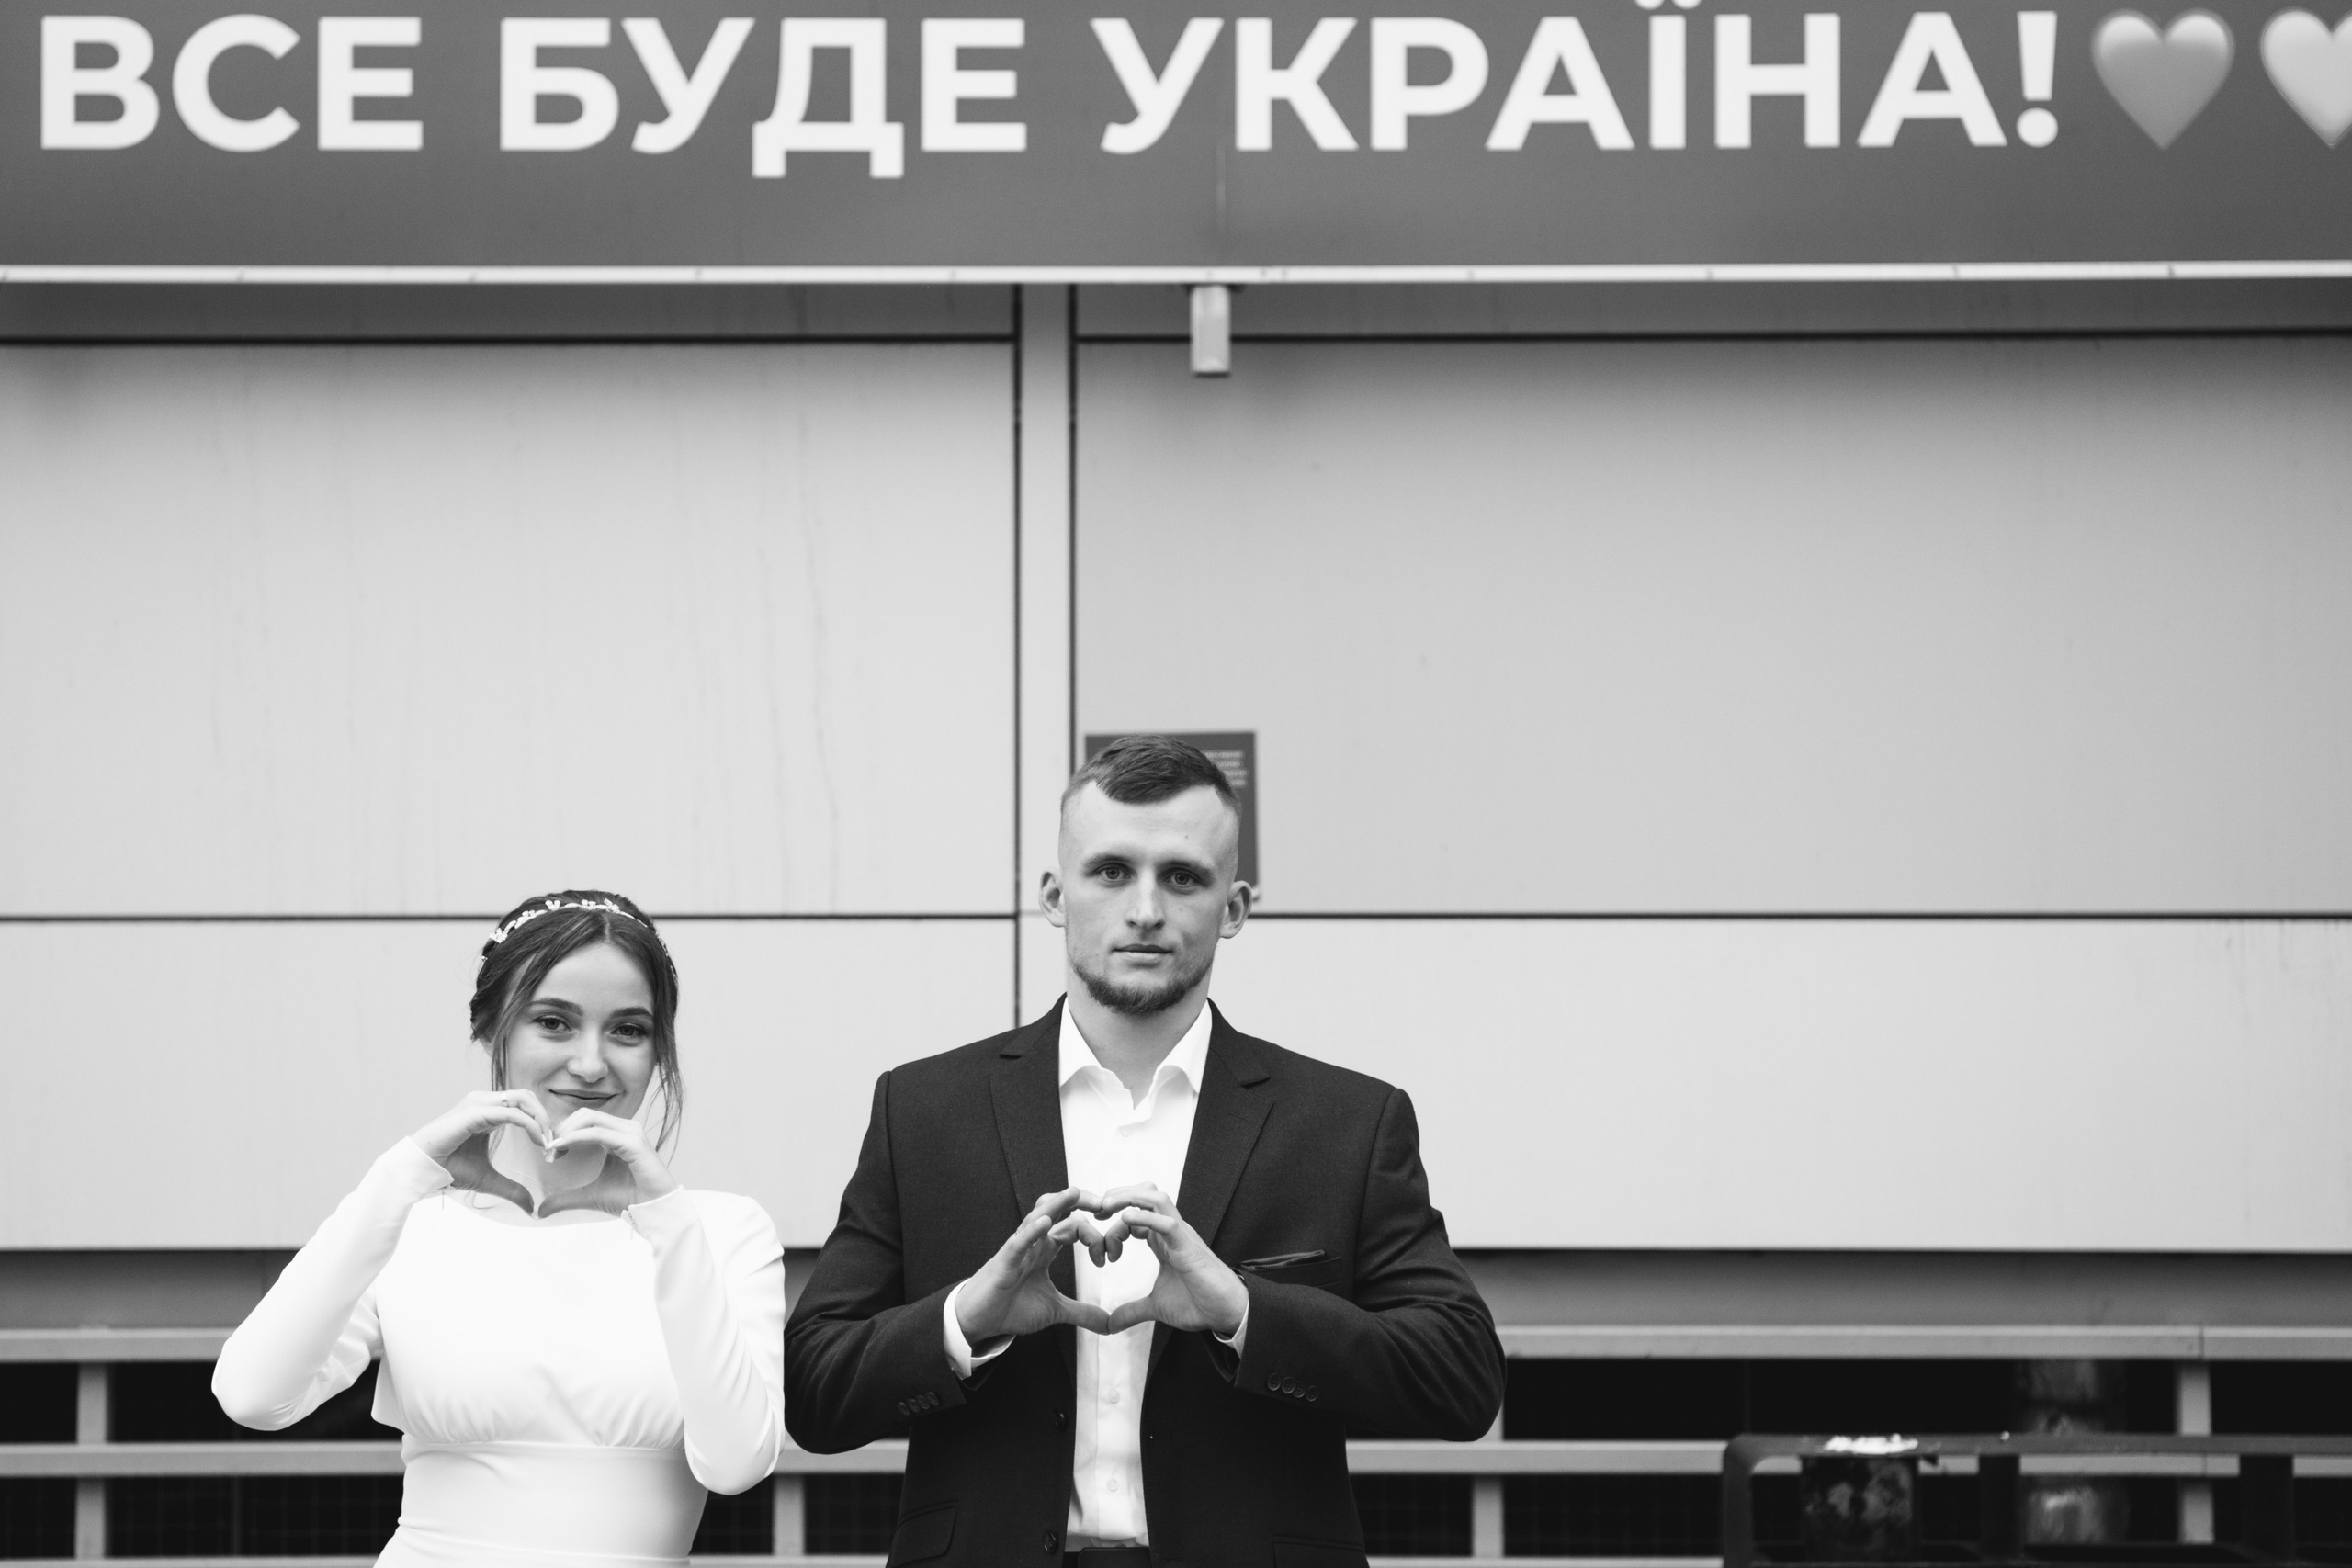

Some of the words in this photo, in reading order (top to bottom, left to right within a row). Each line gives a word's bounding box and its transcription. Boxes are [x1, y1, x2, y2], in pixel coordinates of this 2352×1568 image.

[40, 13, 424, 153] ВСЕ
[499, 16, 1029, 180] БУДЕ
[1090, 0, 2060, 155] УКРАЇНА!
